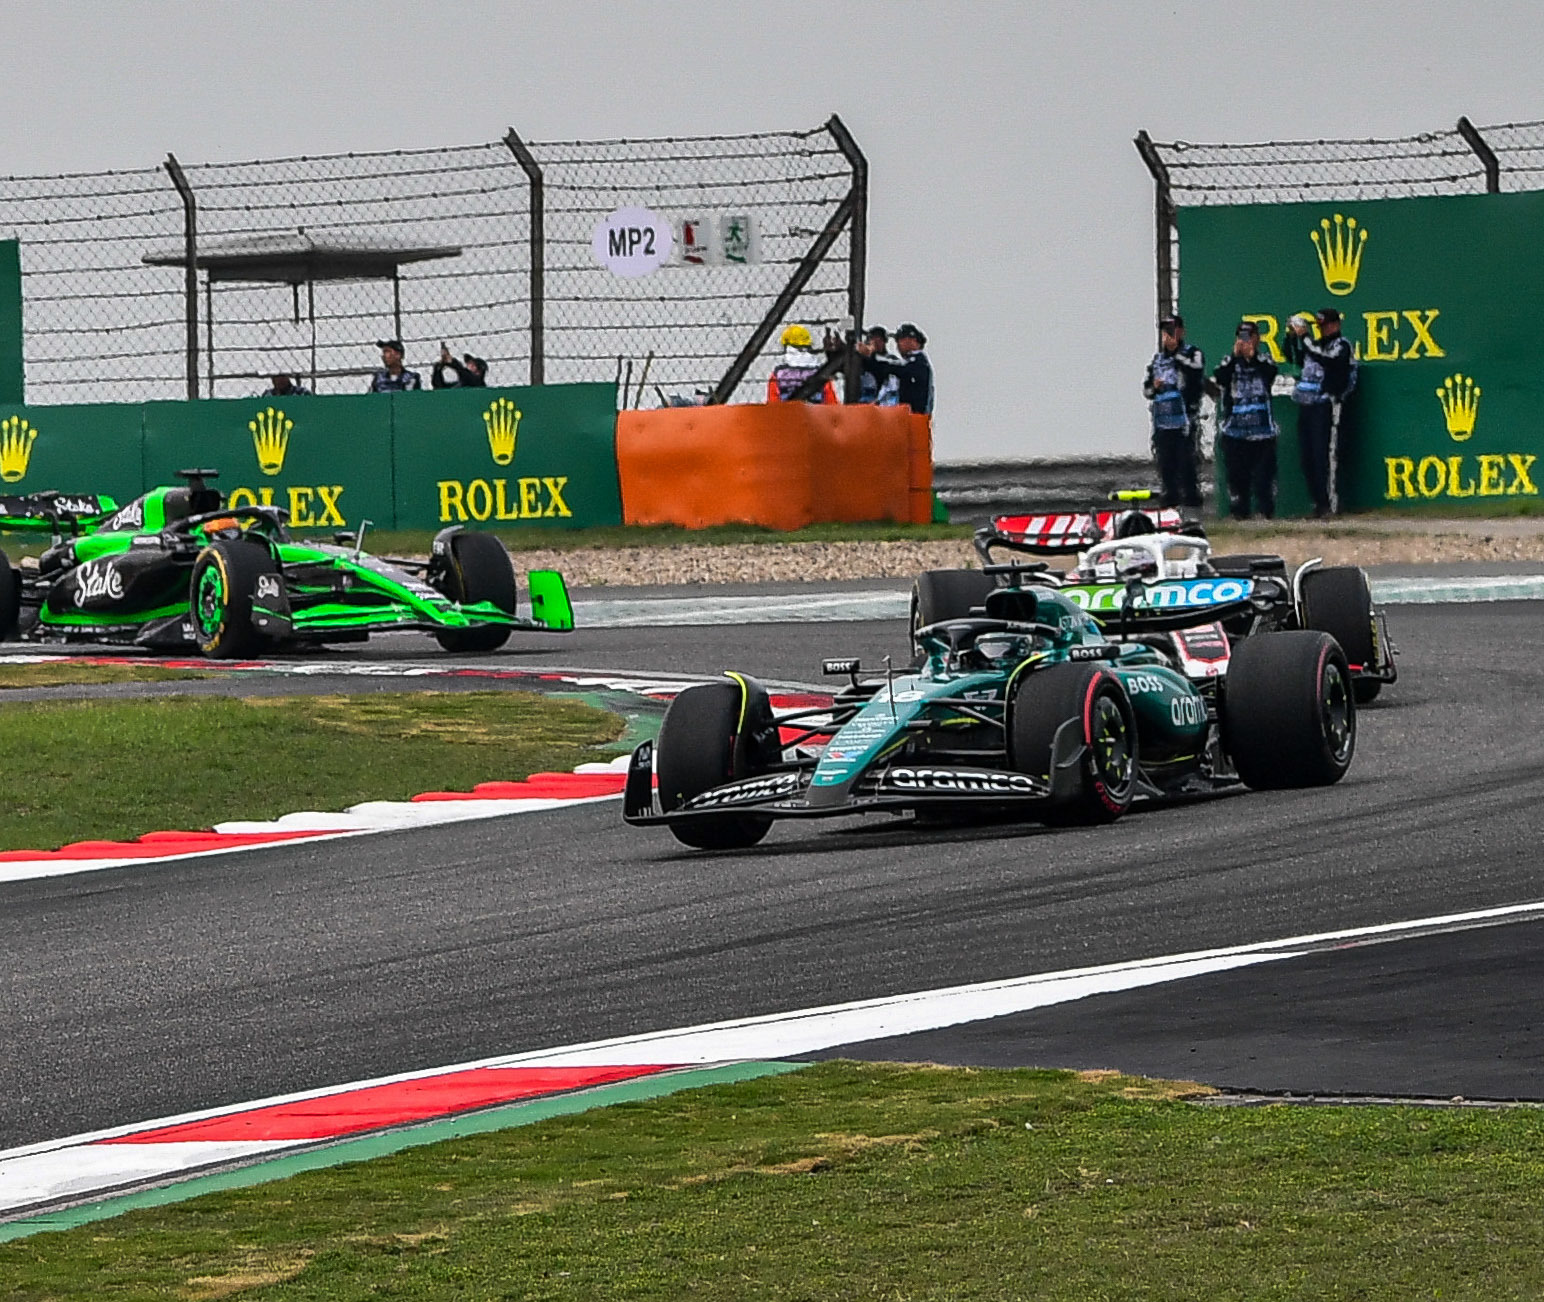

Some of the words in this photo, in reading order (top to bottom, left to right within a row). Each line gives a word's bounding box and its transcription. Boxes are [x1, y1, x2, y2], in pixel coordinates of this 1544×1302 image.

[608, 226, 656, 258] MP2
[1385, 453, 1538, 500] ROLEX
[438, 477, 572, 521] ROLEX
[72, 559, 127, 608] Stake
[1072, 648, 1103, 659] BOSS
[1127, 675, 1164, 696] BOSS
[892, 767, 1034, 792] aramco
